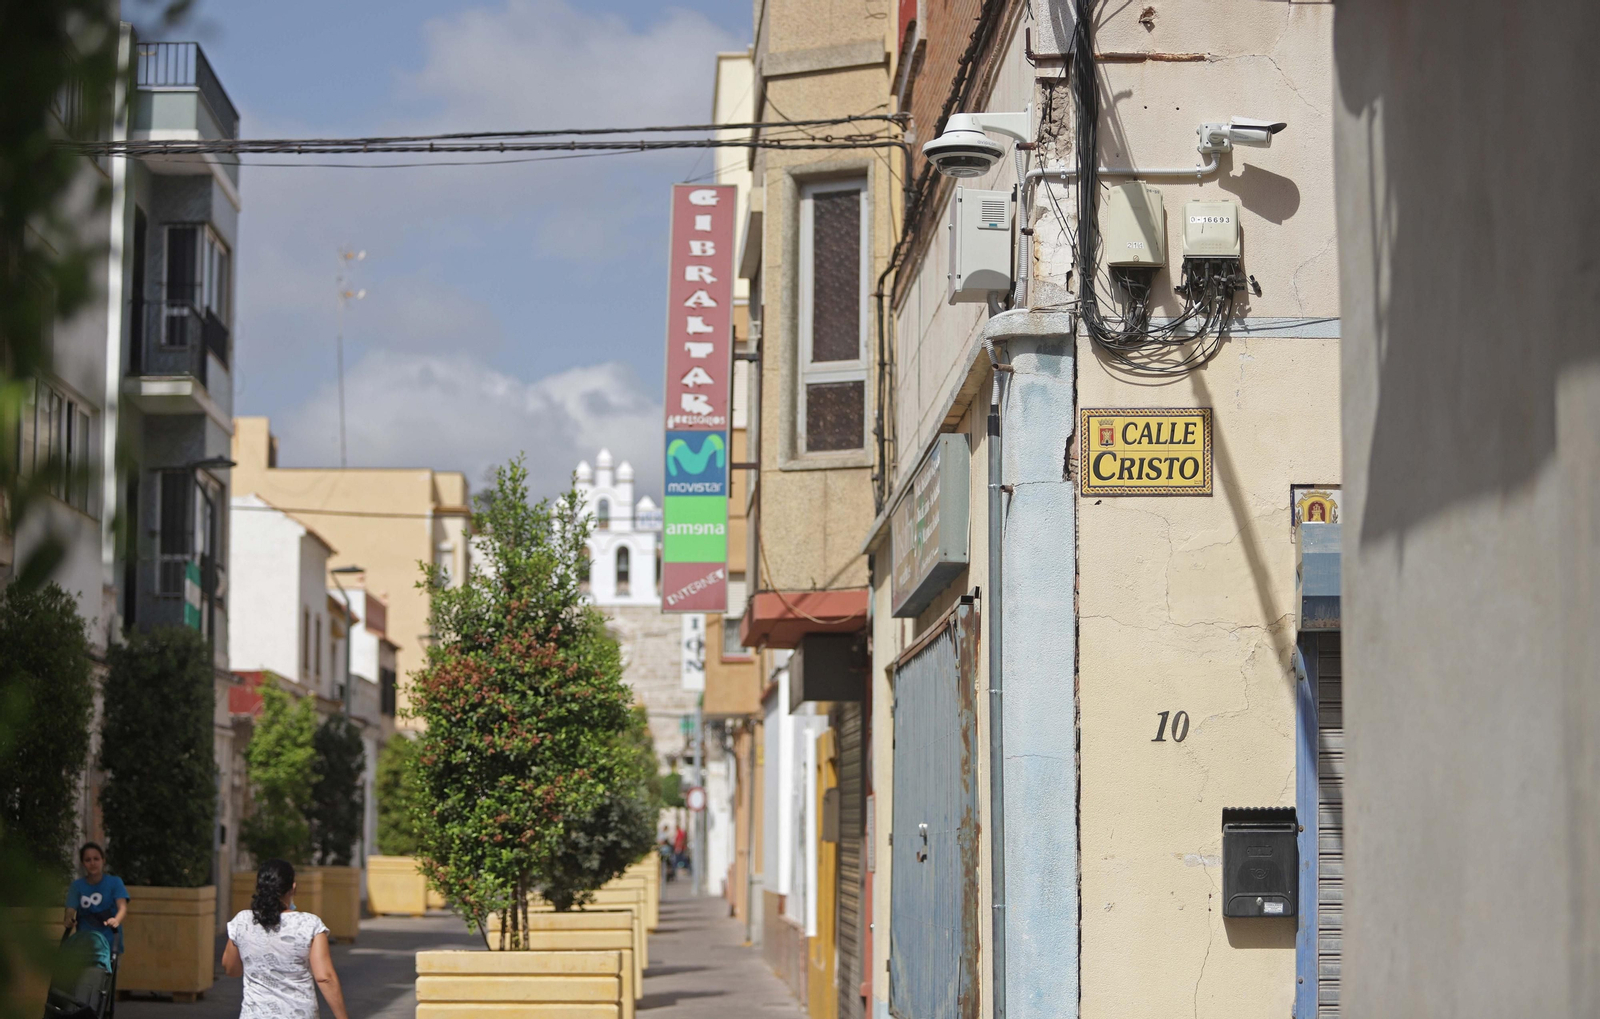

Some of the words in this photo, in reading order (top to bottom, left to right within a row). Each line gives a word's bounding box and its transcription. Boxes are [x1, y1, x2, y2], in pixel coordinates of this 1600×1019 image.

[681, 188, 721, 416] GIBRALTAR
[1121, 421, 1198, 446] CALLE
[1092, 450, 1201, 482] CRISTO
[667, 481, 724, 493] movistar
[665, 522, 726, 536] amena
[665, 568, 725, 606] INTERNET
[1150, 710, 1190, 743] 10
